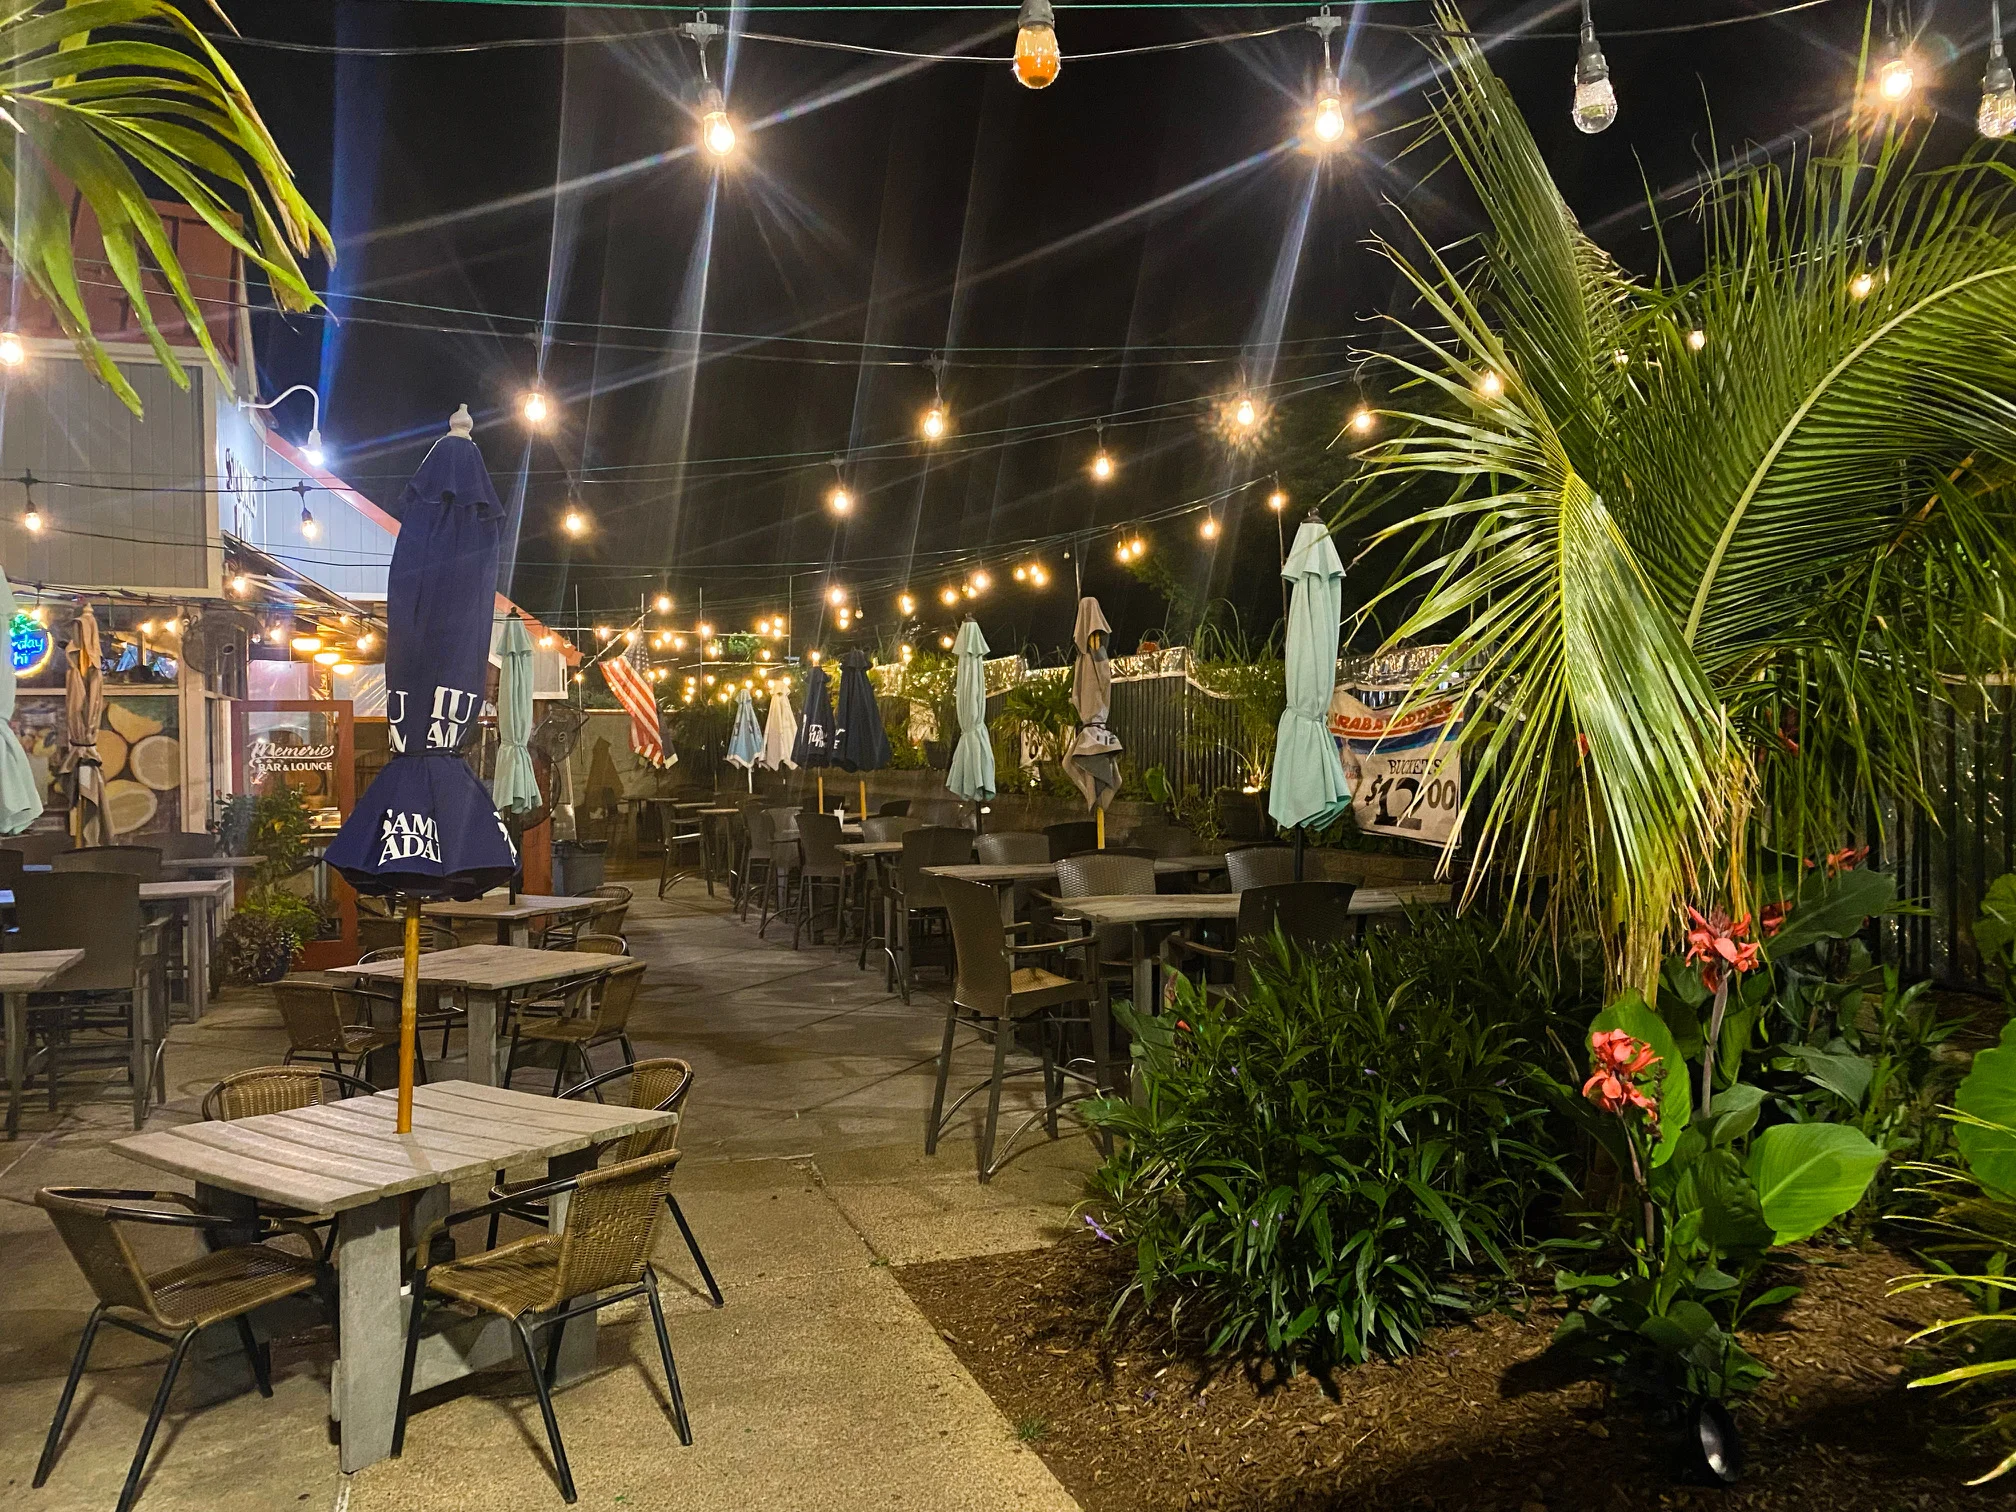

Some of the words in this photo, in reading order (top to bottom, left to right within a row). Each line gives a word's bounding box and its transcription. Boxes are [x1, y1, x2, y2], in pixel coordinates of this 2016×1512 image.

[246, 741, 335, 760] Memories
[259, 762, 281, 772] BAR
[282, 764, 290, 772] &
[291, 762, 333, 771] LOUNGE
[1388, 758, 1442, 775] BUCKETS
[377, 835, 443, 867] ADA
